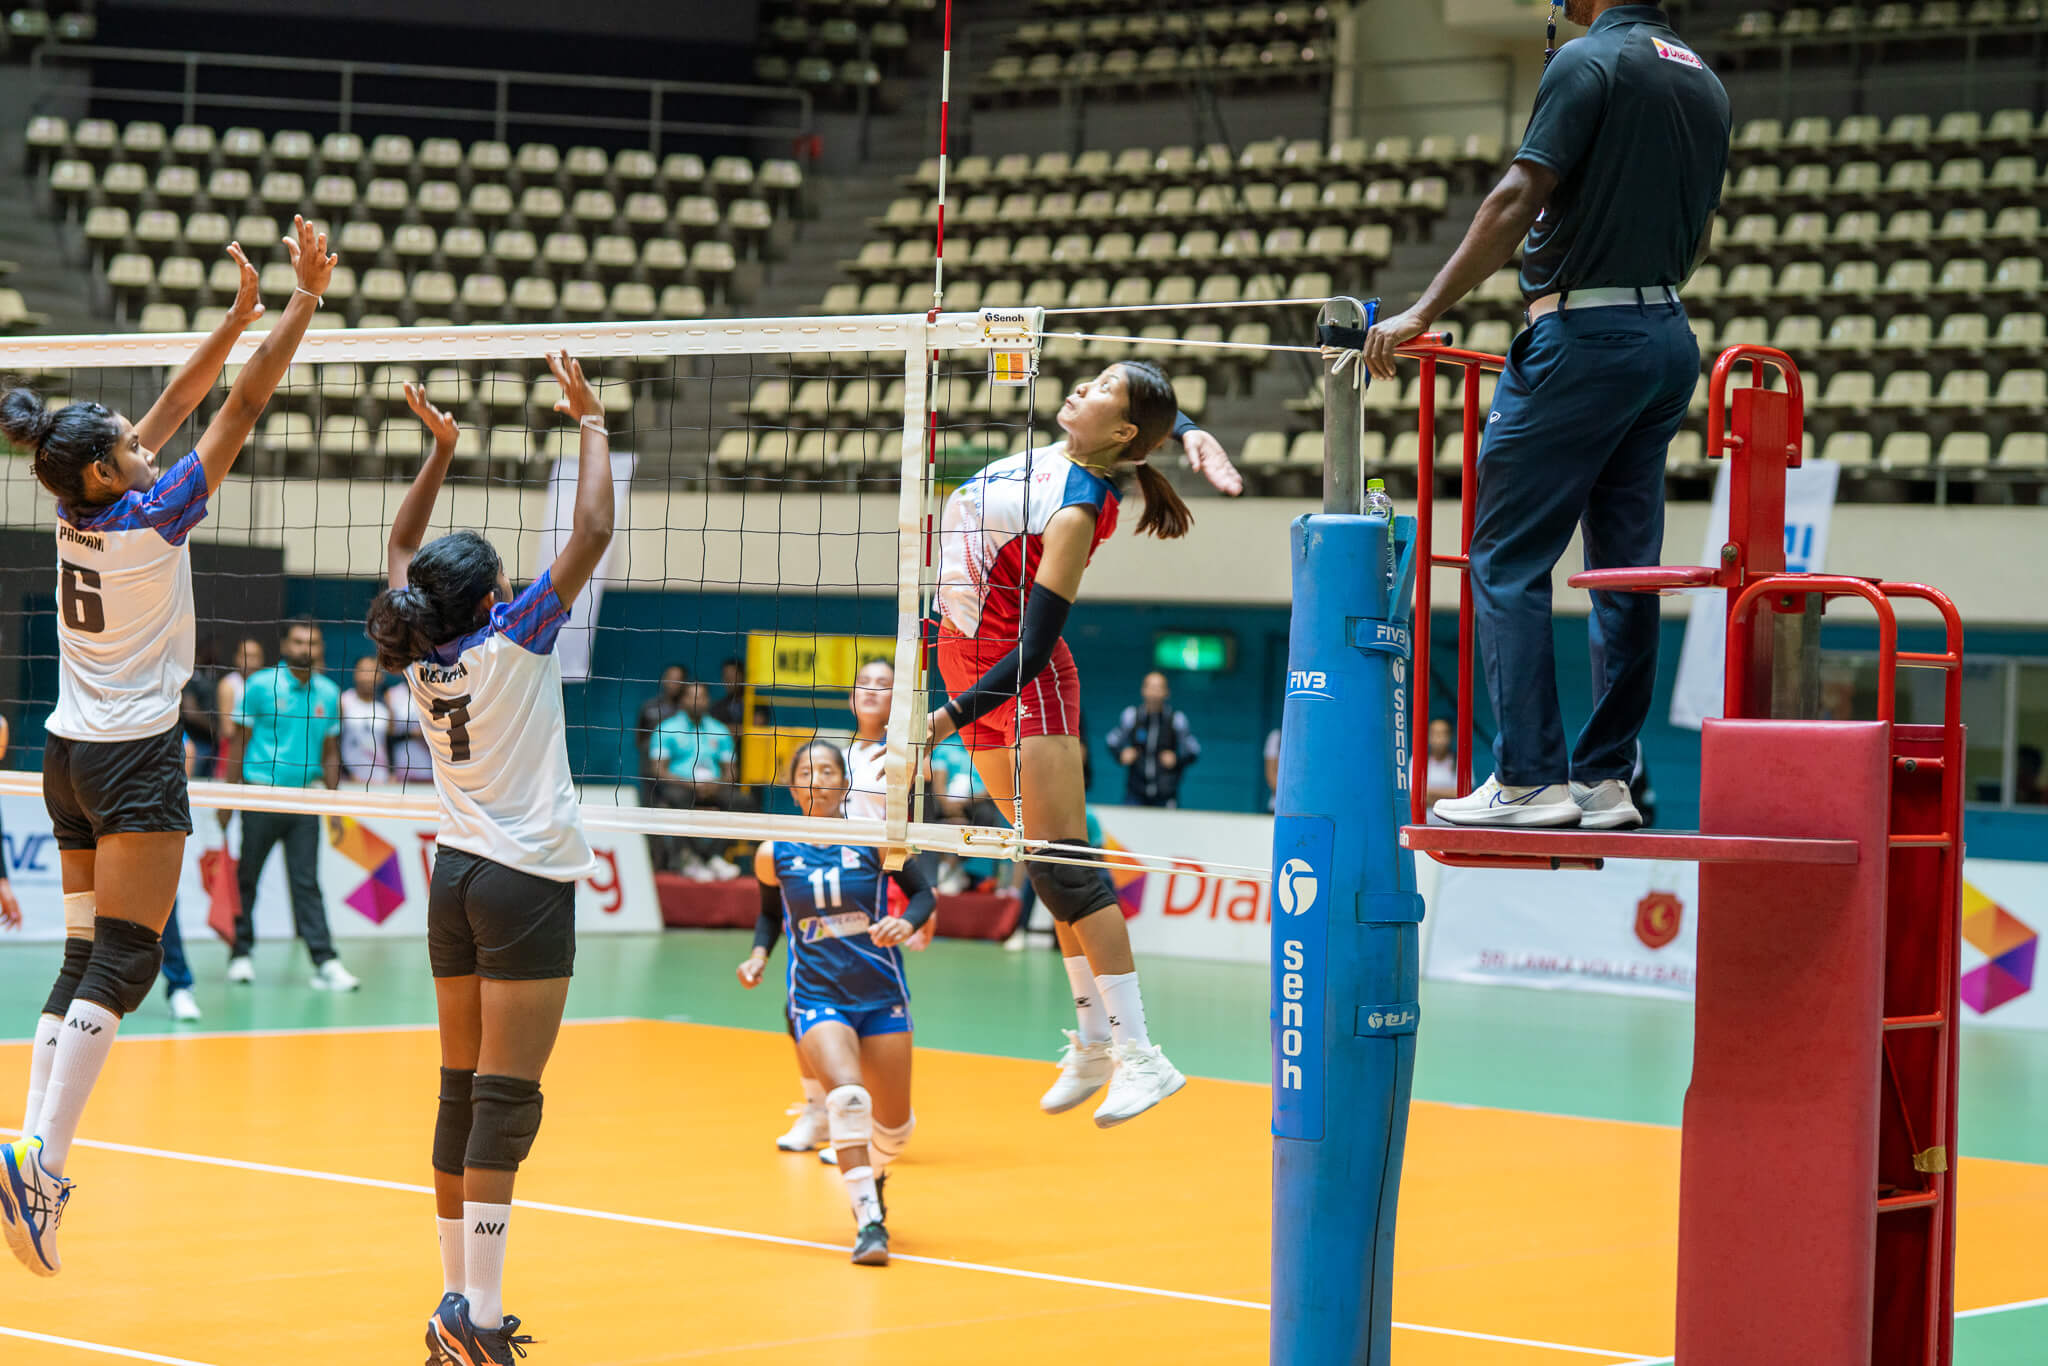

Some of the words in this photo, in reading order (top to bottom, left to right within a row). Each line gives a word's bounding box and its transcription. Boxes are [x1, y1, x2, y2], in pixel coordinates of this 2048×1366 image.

[993, 313, 1025, 322] Senoh
[60, 526, 105, 553] PAWANI
[61, 558, 105, 634] 6
[1376, 624, 1407, 645] FIVB
[1289, 671, 1328, 689] FIVB
[429, 694, 473, 762] 7
[808, 866, 842, 910] 11
[1282, 939, 1304, 1091] Senoh
